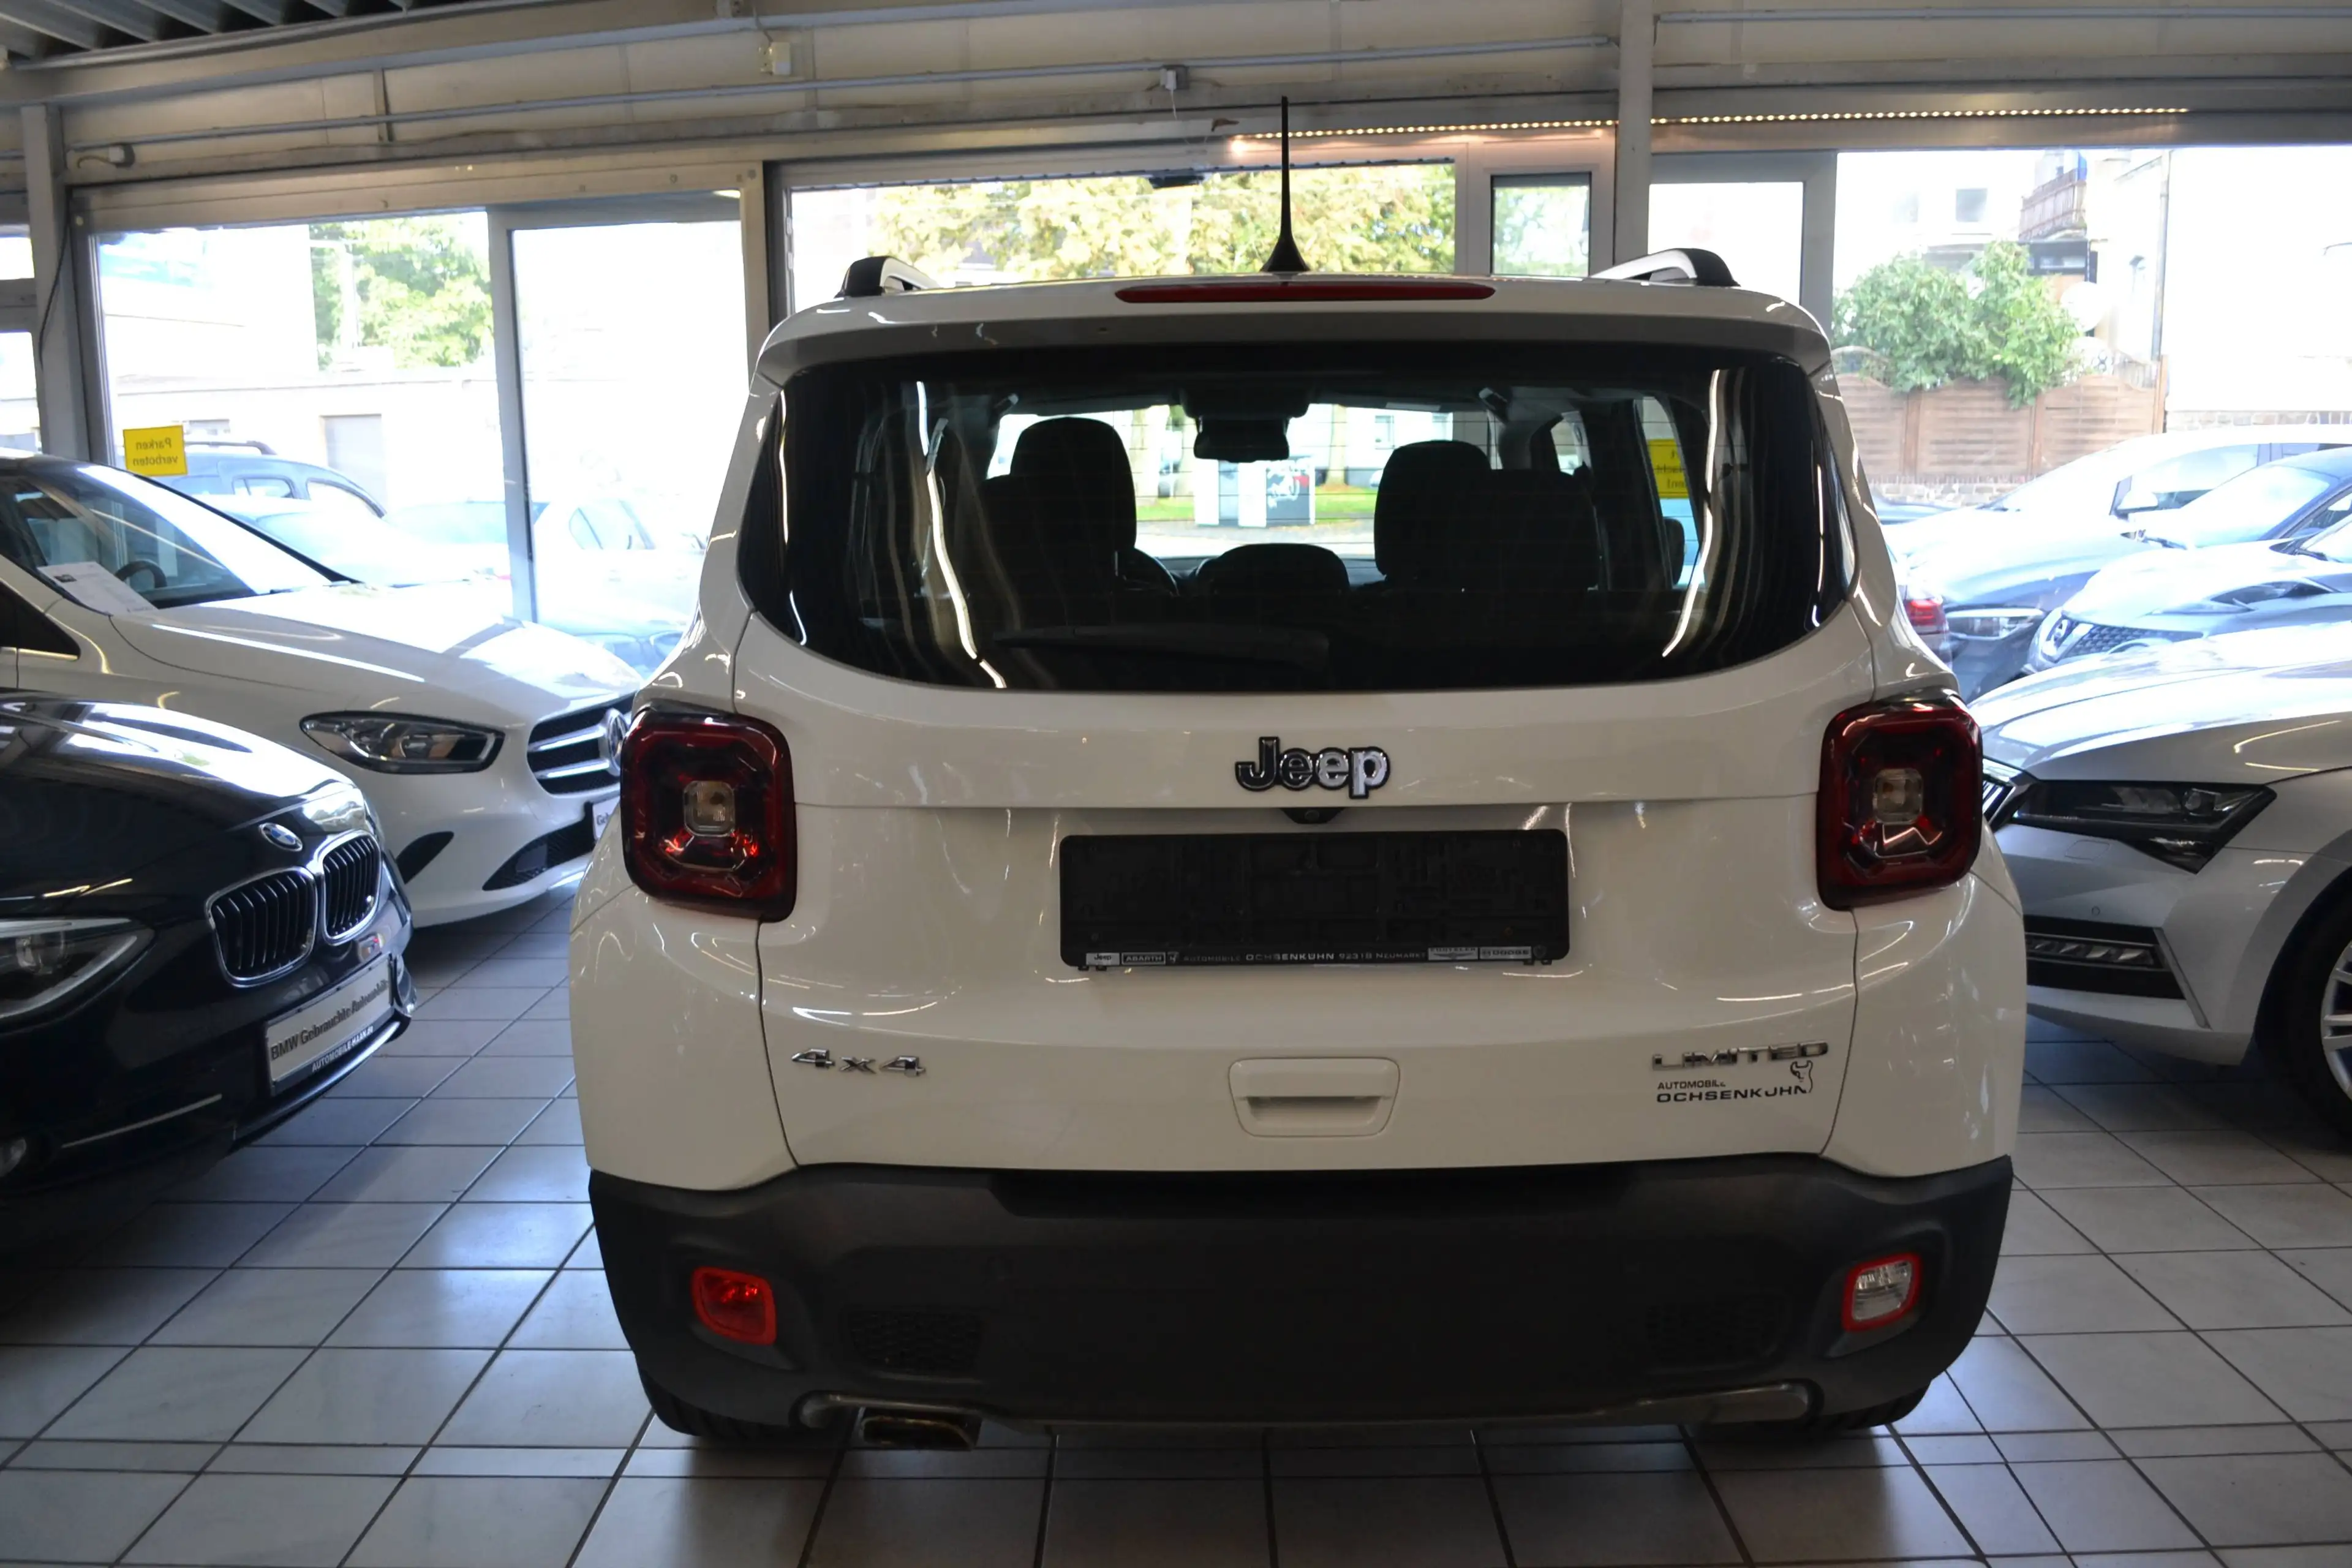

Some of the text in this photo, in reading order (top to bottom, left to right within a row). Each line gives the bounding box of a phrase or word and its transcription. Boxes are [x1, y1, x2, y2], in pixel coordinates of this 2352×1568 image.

[1235, 736, 1390, 798] Jeep
[271, 1033, 298, 1061] BMW
[301, 1008, 351, 1044] Gebrauchte
[1653, 1041, 1828, 1069] LIMITED
